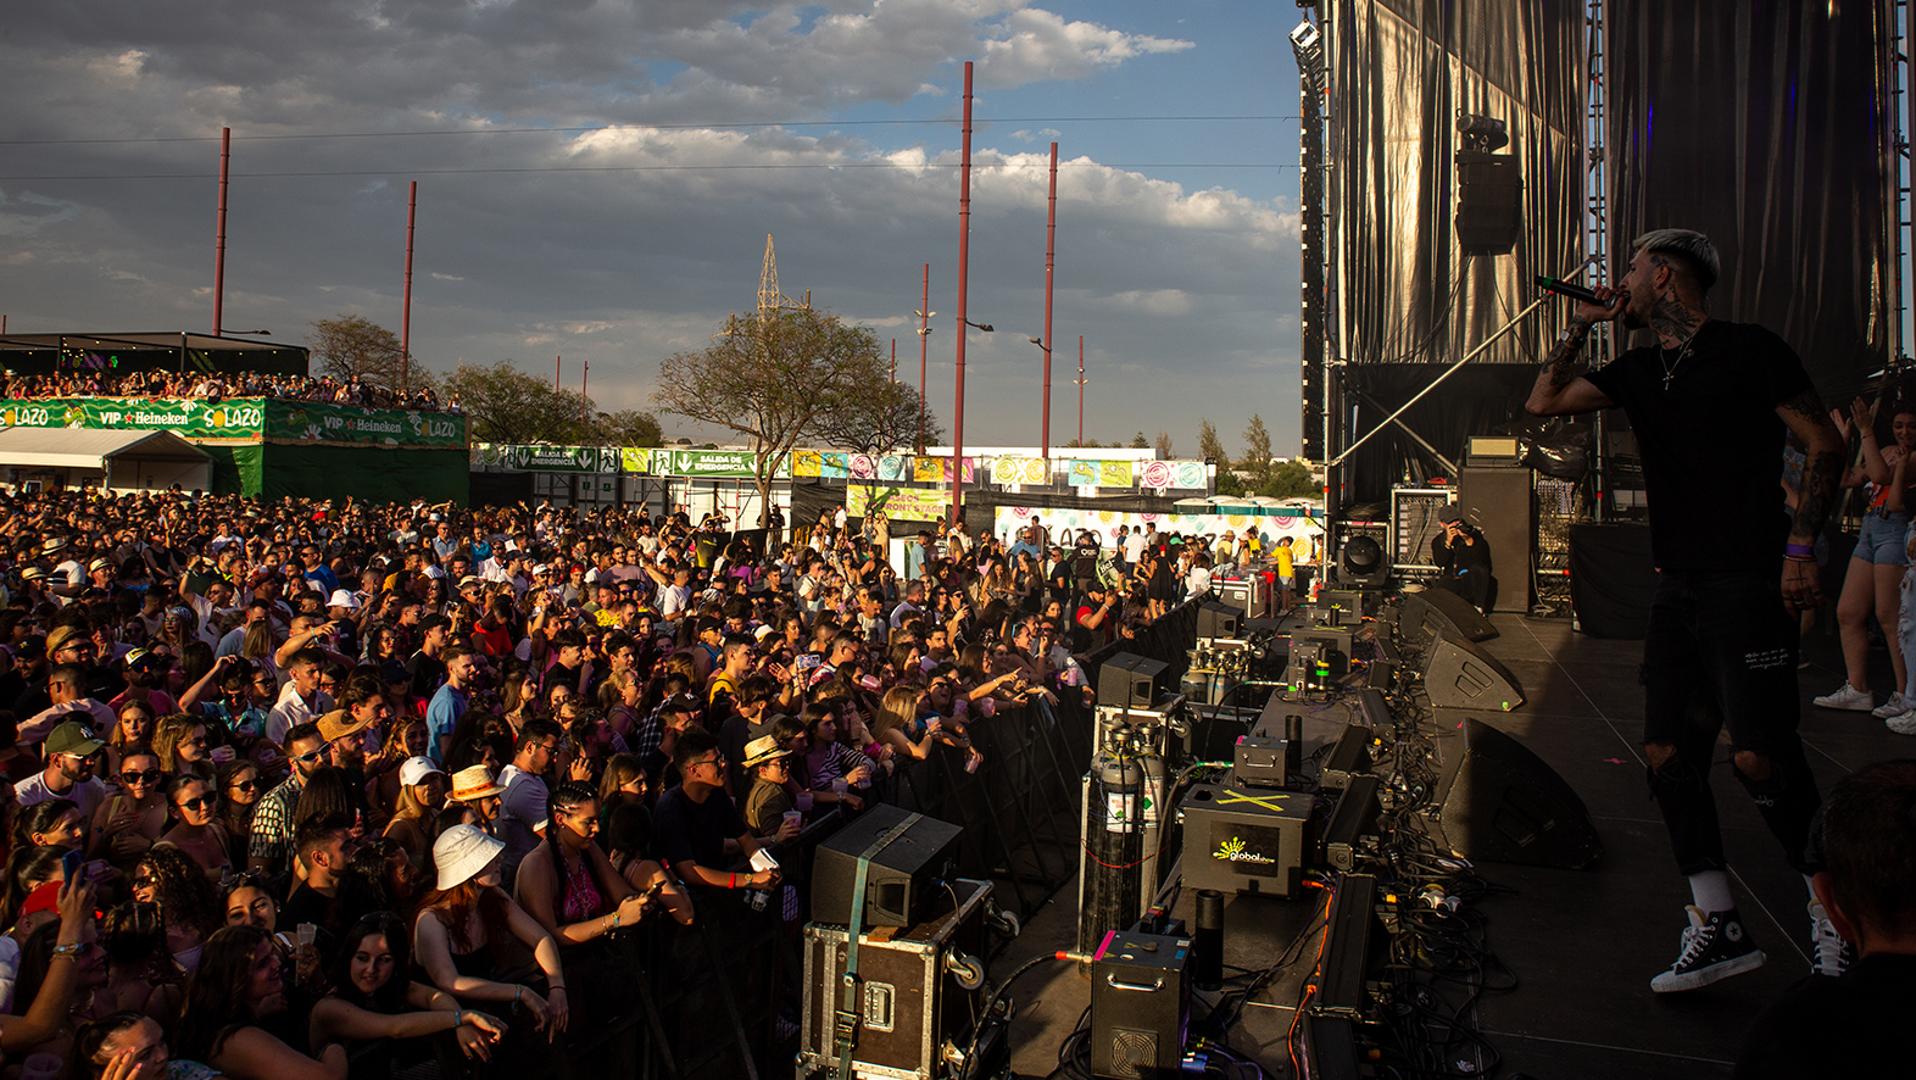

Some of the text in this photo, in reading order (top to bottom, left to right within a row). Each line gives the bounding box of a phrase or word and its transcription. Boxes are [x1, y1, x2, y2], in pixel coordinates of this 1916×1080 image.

[100, 411, 188, 425] VIP Heineken
[203, 407, 261, 427] SOLAZO
[324, 416, 402, 433] VIP Heineken
[413, 420, 456, 437] SOLAZO
[700, 455, 742, 464] SALIDA DE
[914, 504, 944, 514] STAGE
